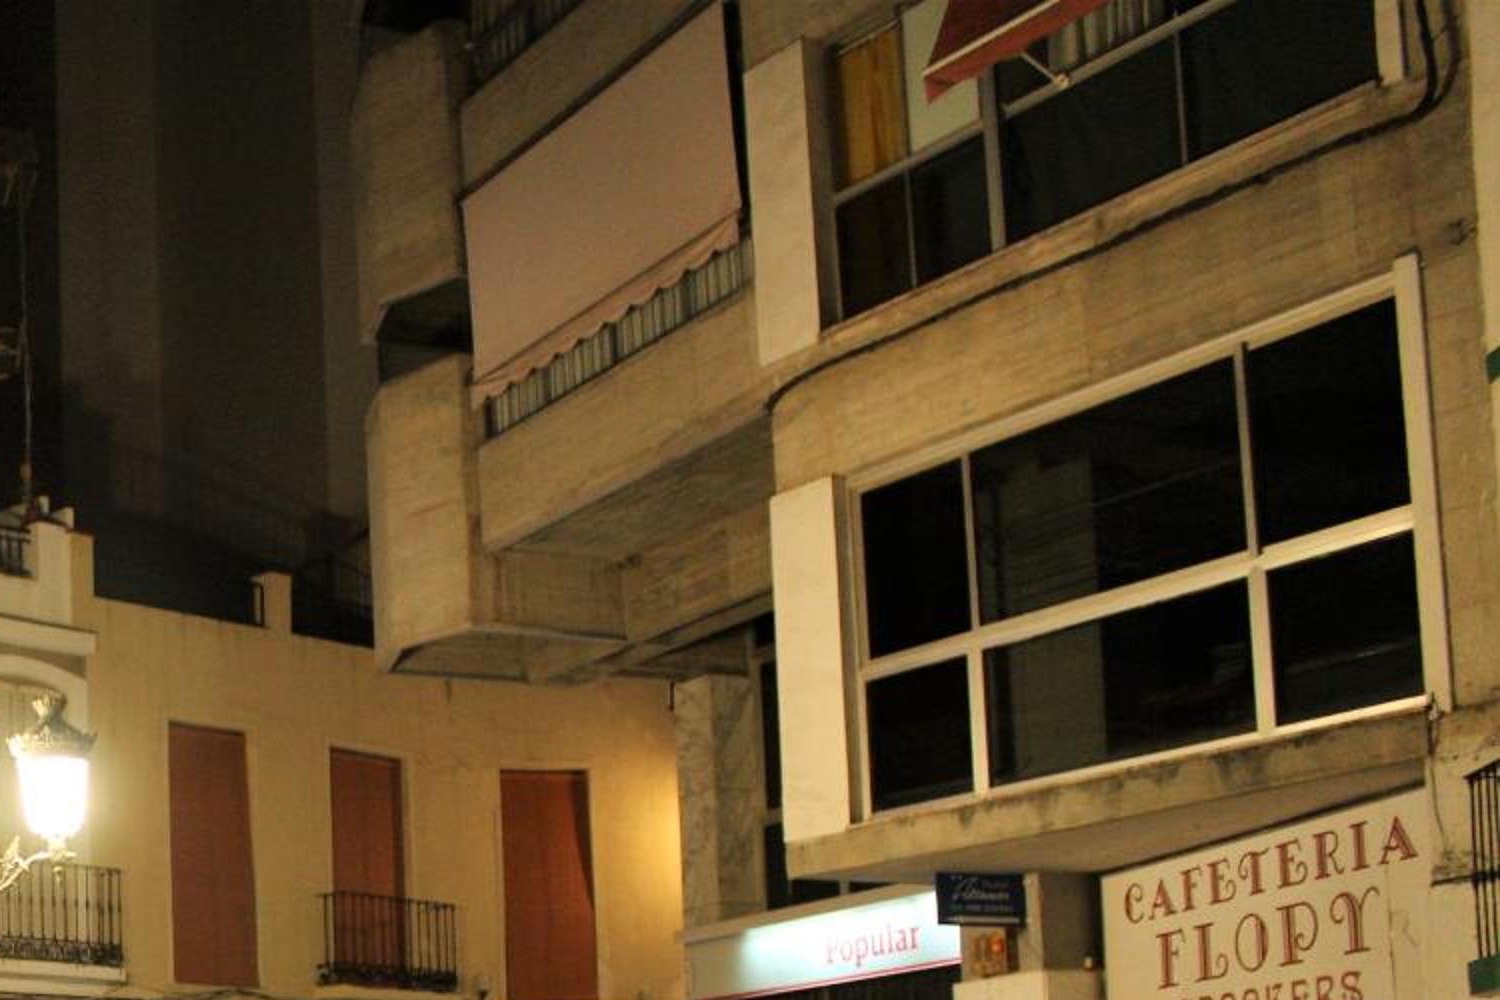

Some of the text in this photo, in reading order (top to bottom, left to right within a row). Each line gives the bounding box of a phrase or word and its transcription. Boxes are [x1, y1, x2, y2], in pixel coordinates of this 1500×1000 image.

[1124, 816, 1418, 924] CAFETERIA
[825, 923, 920, 967] Popular
[1156, 887, 1380, 989] FLOPY
